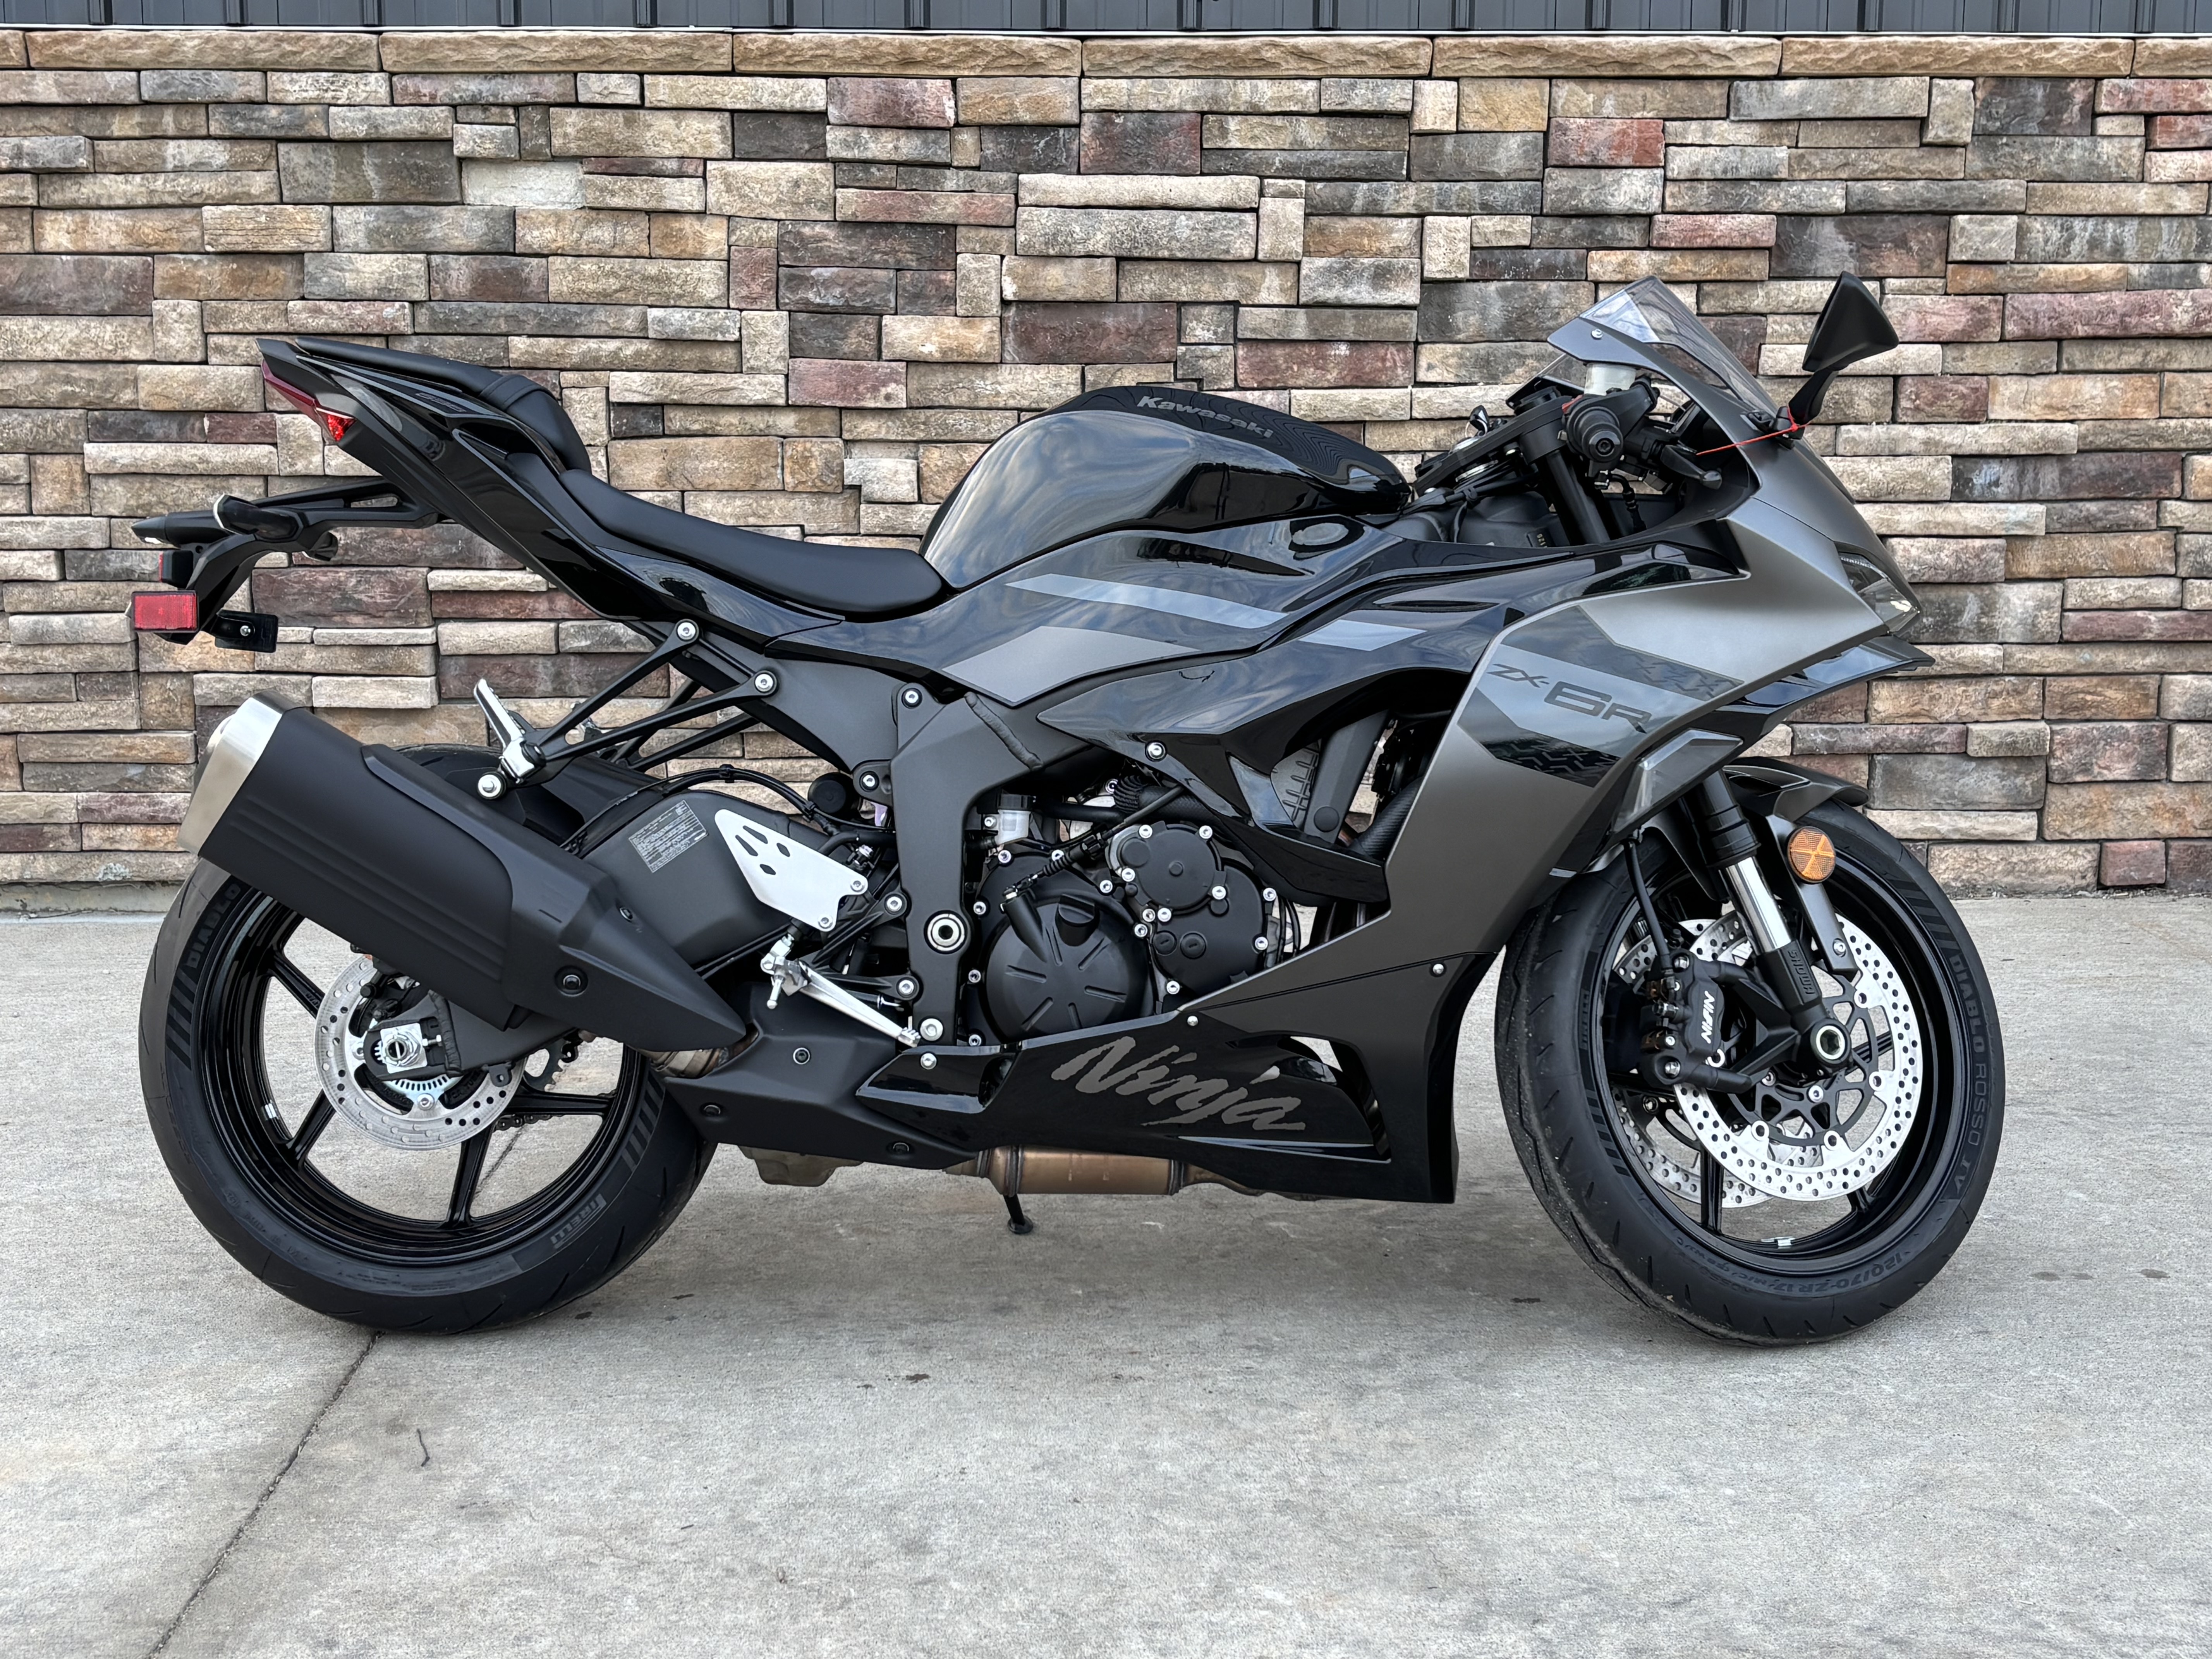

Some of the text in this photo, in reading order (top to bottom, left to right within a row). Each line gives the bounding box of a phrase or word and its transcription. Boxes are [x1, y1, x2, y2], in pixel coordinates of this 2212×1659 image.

[1137, 396, 1274, 438] Kawasaki
[1487, 663, 1652, 734] ZX-6R
[186, 883, 241, 969] DIABLO
[1788, 950, 1815, 994] SHOWA
[1051, 1036, 1306, 1130] Ninja
[1949, 954, 1987, 1195] DIABLO ROSSO IV
[550, 1193, 607, 1249] PIRELLI
